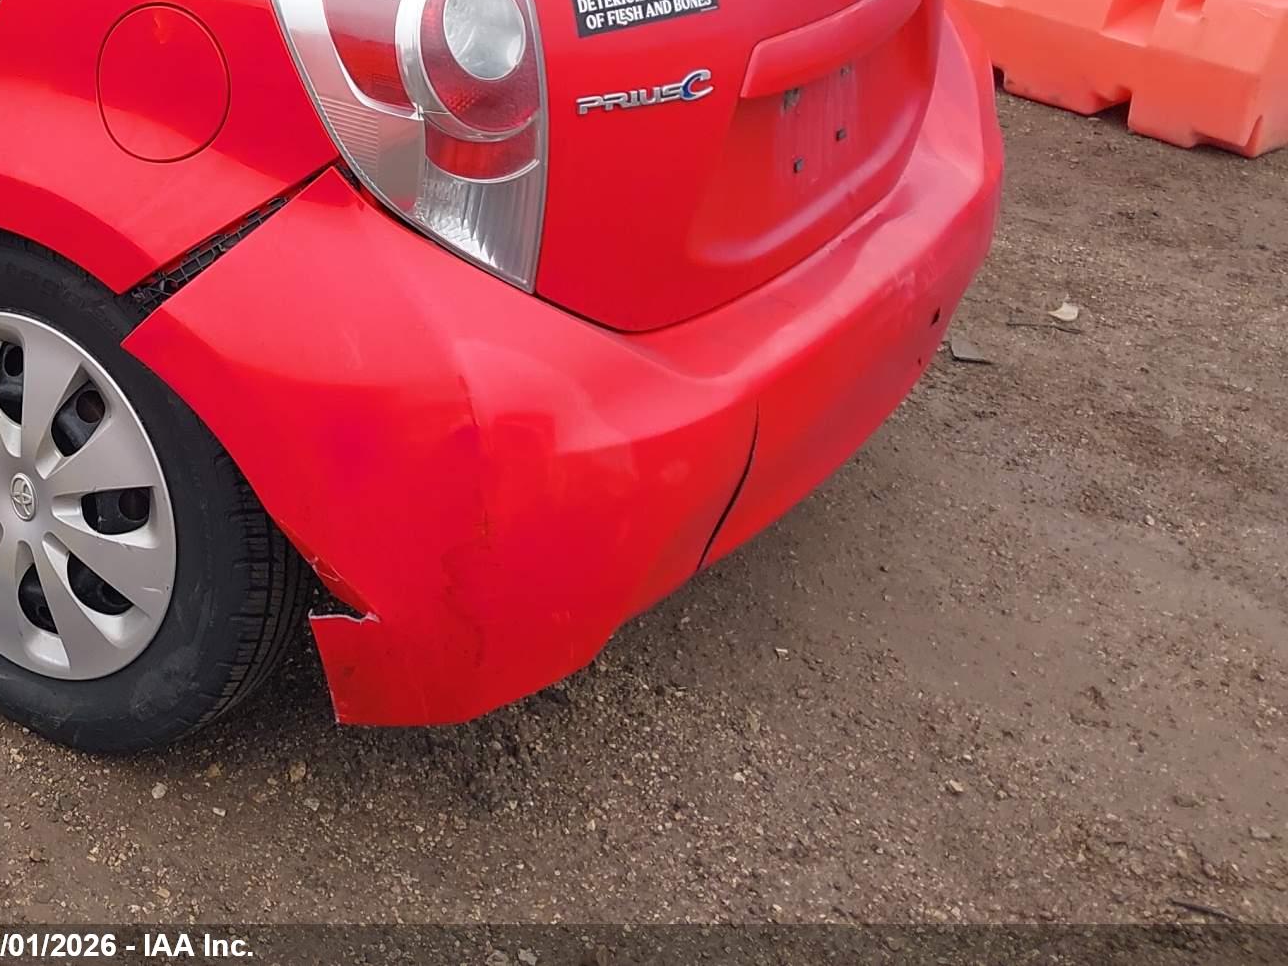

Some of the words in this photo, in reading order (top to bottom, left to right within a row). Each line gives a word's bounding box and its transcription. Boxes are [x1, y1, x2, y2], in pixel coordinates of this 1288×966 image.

[586, 13, 605, 29] OF
[607, 5, 644, 25] FLESH
[646, 0, 672, 18] AND
